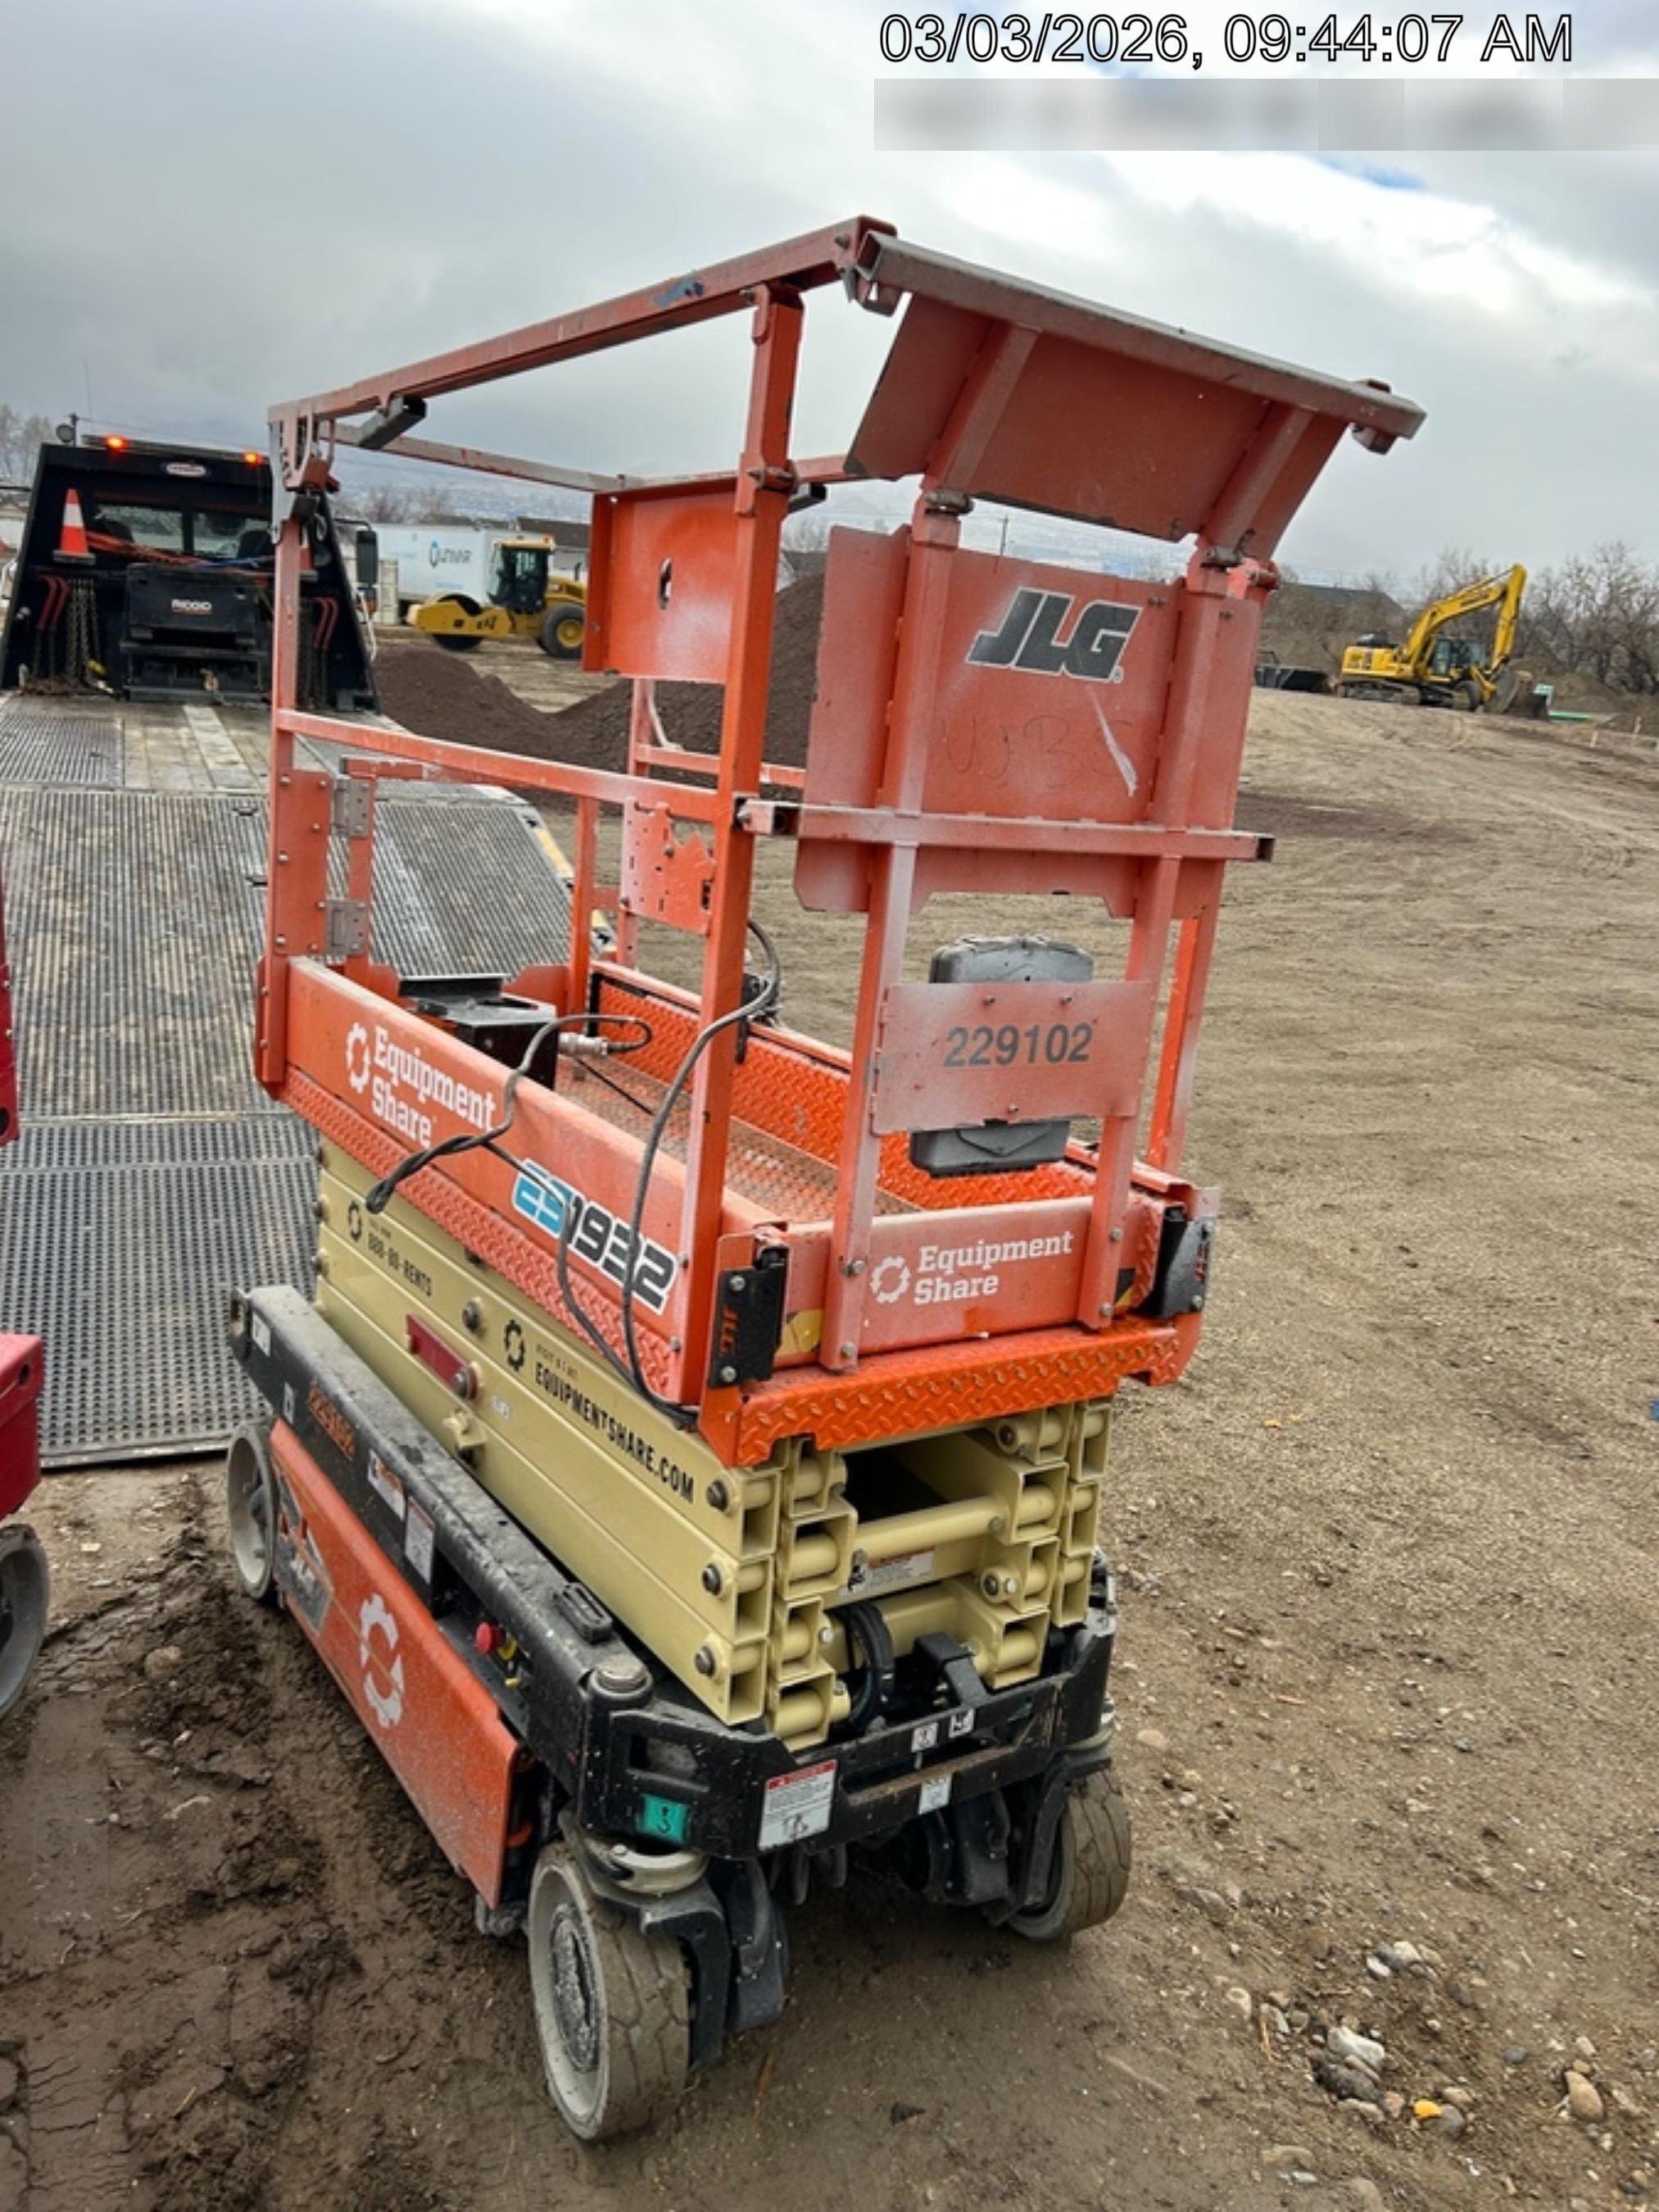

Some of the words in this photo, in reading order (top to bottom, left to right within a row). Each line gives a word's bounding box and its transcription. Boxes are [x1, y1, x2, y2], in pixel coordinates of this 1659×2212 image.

[965, 586, 1144, 684] JLG
[374, 1024, 497, 1134] Equipment
[944, 1022, 1093, 1067] 229102
[372, 1075, 432, 1149] Share
[913, 1274, 999, 1305] Share
[917, 1230, 1075, 1276] Equipment
[535, 1361, 695, 1504] EQUIPMENTSHARE.COM
